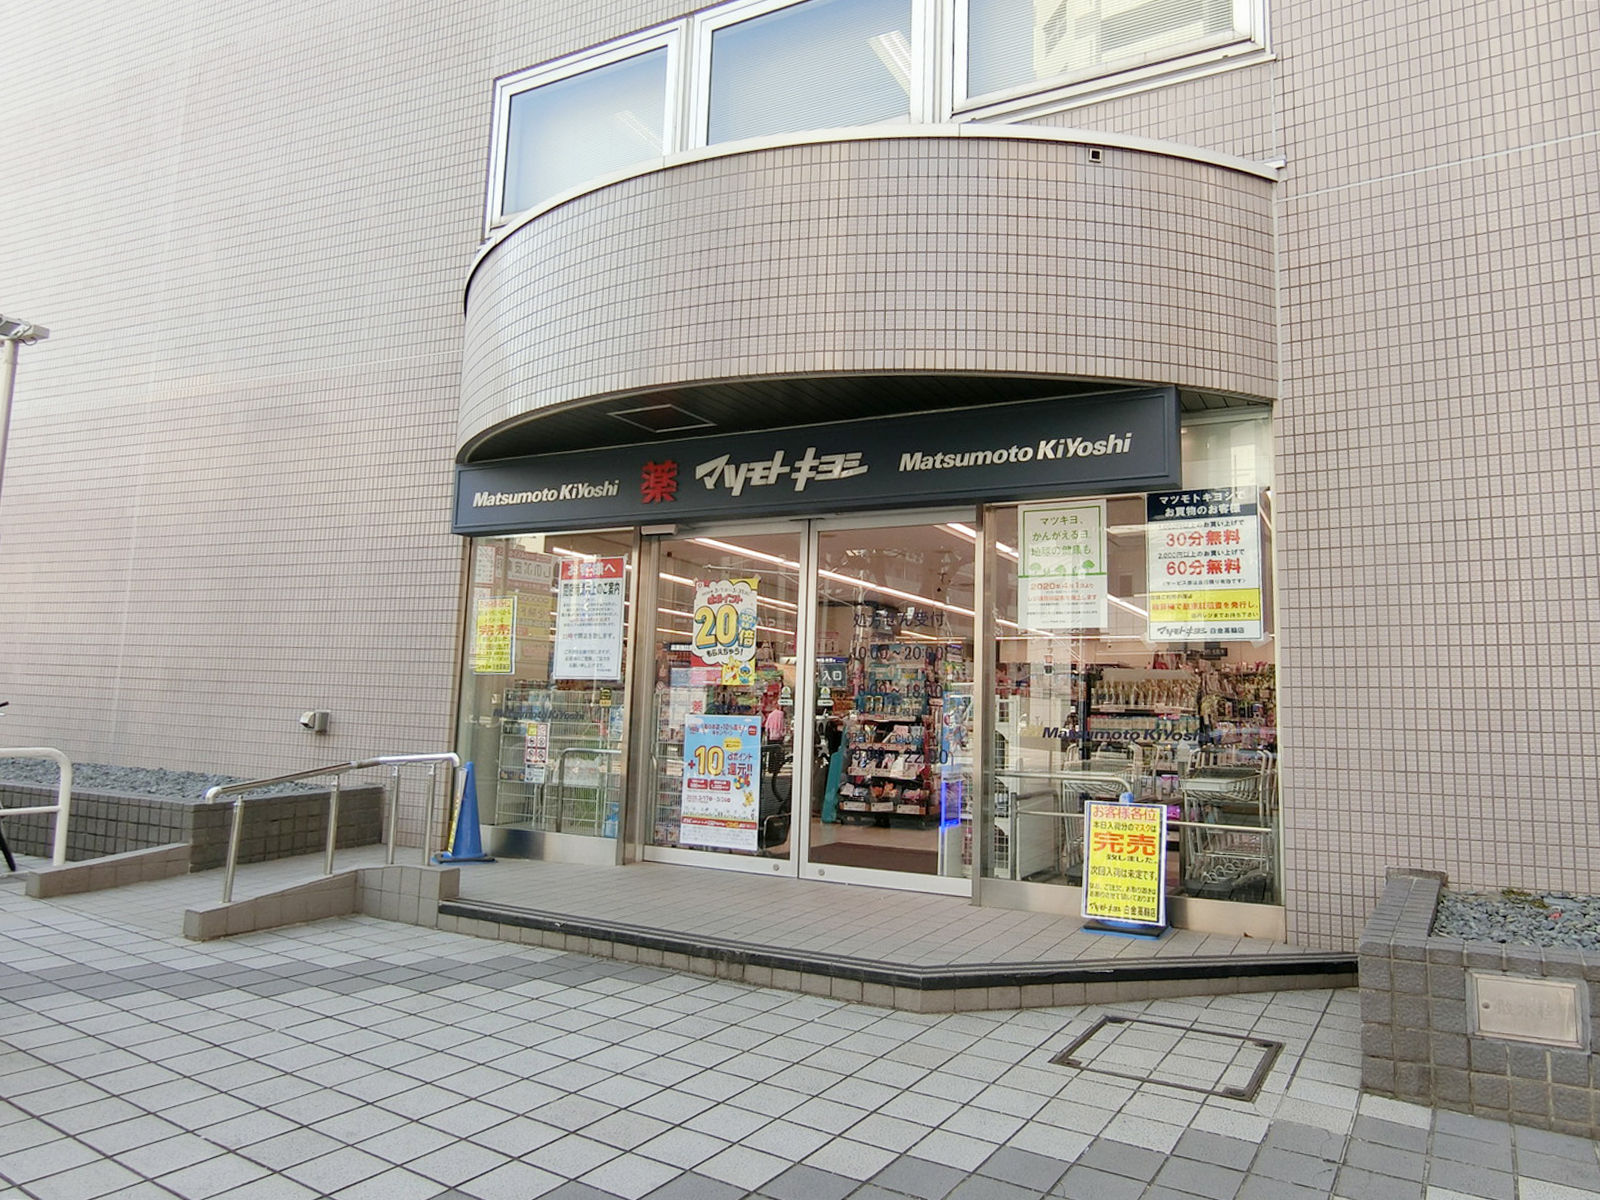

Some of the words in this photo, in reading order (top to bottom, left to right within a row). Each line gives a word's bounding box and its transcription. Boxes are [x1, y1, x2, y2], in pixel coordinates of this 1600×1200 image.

[898, 444, 1034, 473] Matsumoto
[1036, 432, 1133, 461] KiYoshi
[472, 487, 558, 508] Matsumoto
[559, 479, 620, 500] KiYoshi
[640, 460, 679, 504] 薬
[1166, 528, 1241, 548] 30分無料
[1166, 558, 1241, 576] 60分無料
[1092, 805, 1157, 821] お客様各位
[1093, 831, 1156, 856] 完売
